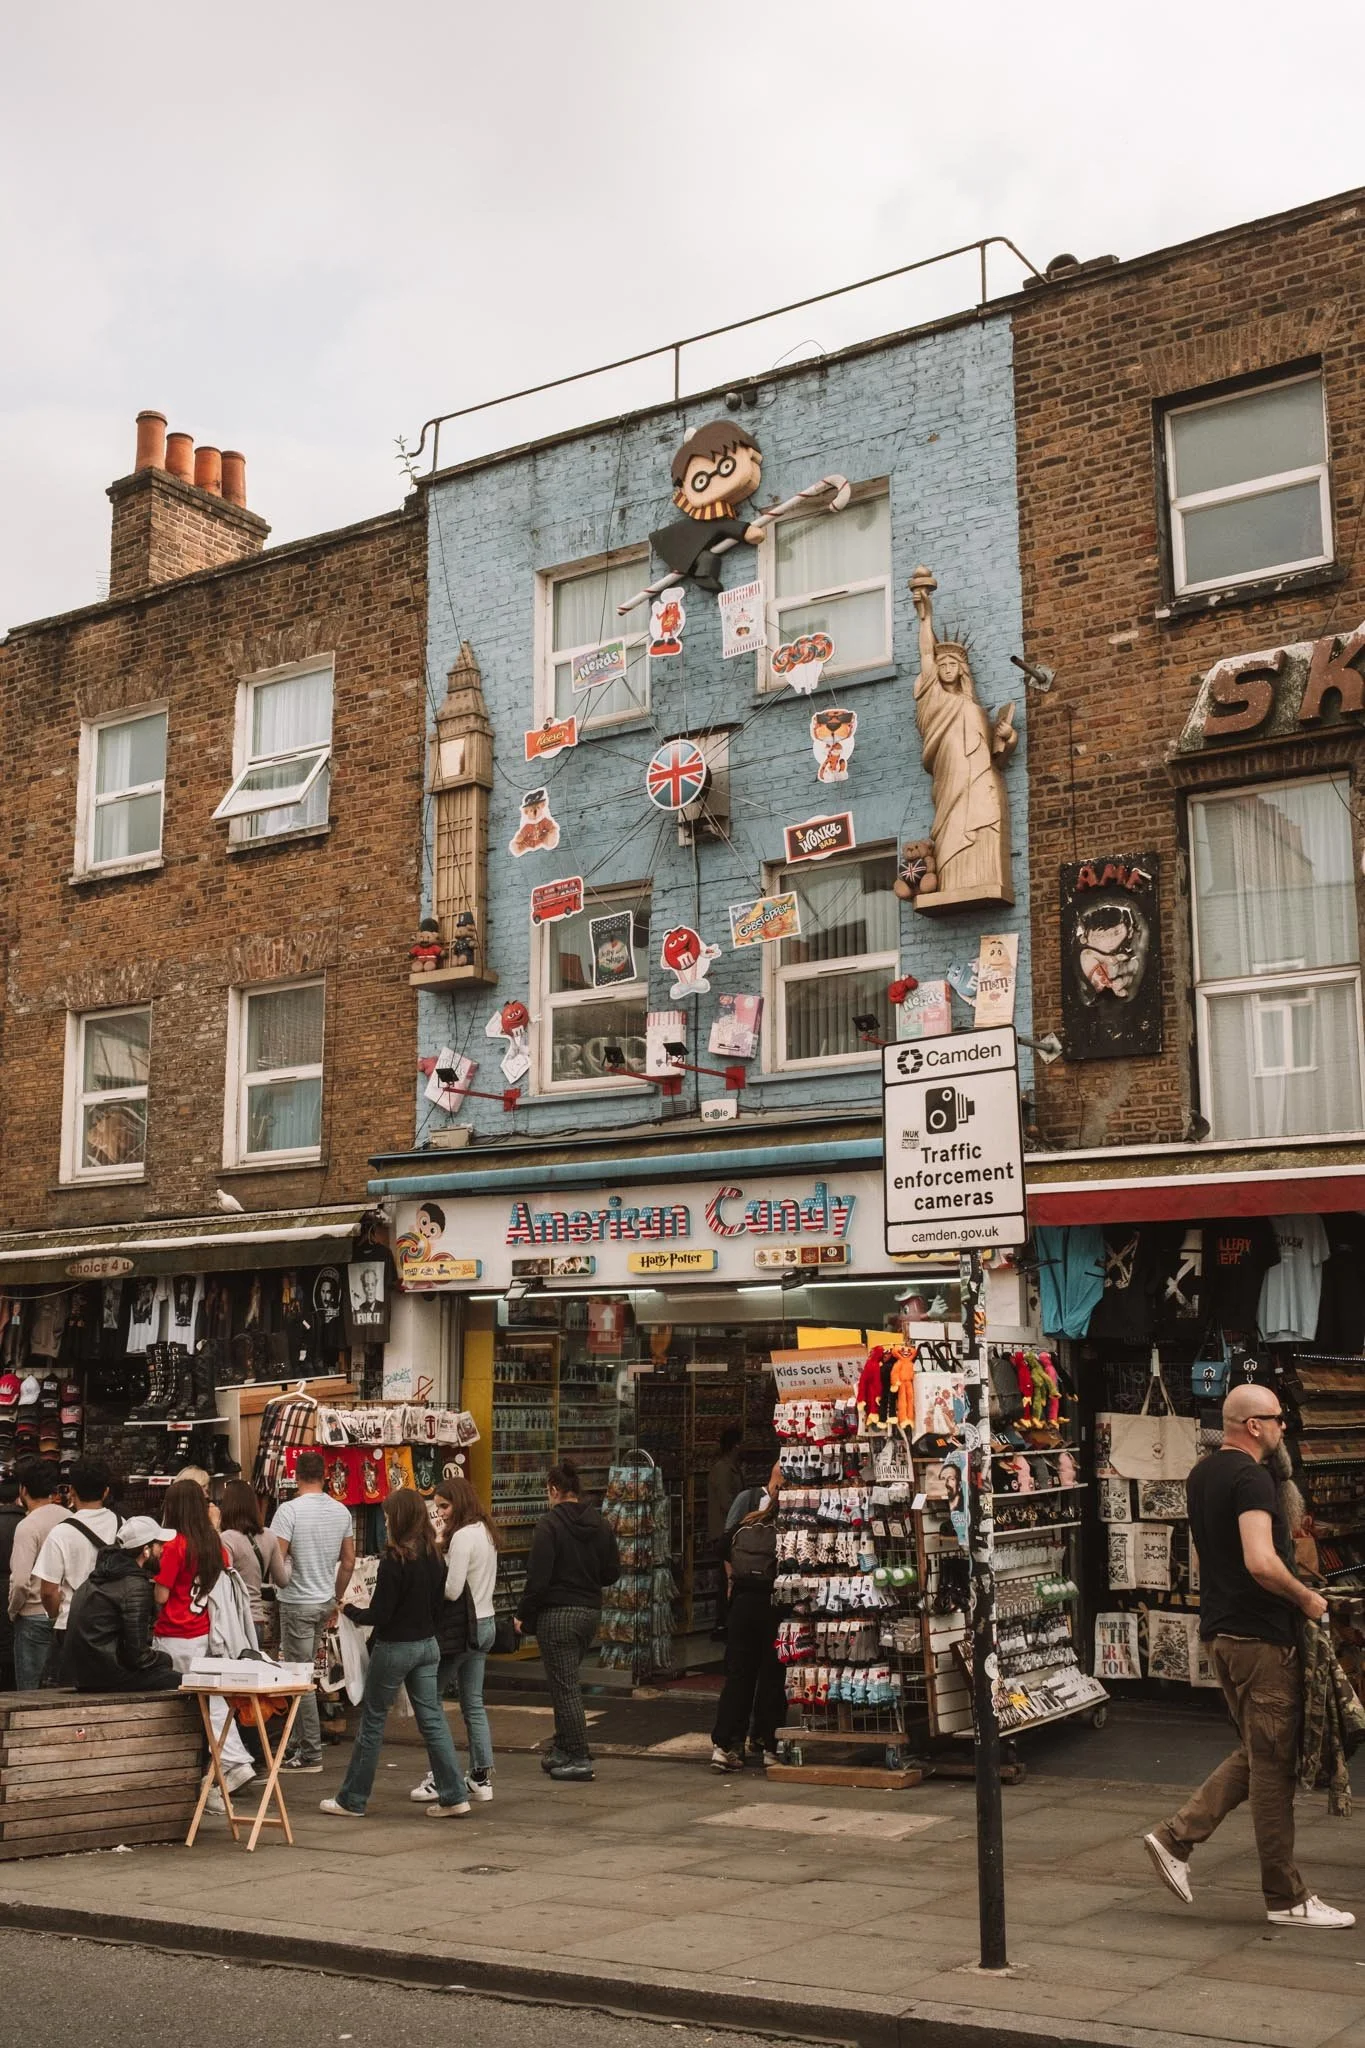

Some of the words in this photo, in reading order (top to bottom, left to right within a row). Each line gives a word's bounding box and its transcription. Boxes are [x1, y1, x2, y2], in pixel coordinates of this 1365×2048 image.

[799, 823, 842, 853] WONKA
[819, 838, 837, 849] BAR
[740, 903, 791, 937] GOBSTOPPER
[926, 1044, 1002, 1066] Camden
[921, 1143, 982, 1164] Traffic
[894, 1162, 1014, 1189] enforcement
[914, 1191, 994, 1210] cameras
[505, 1195, 692, 1246] American
[705, 1181, 857, 1239] Candy
[911, 1226, 999, 1243] camden.gov.uk
[70, 1262, 108, 1274] choice
[111, 1260, 118, 1271] 4
[122, 1261, 130, 1270] u
[639, 1255, 669, 1268] Harry
[670, 1252, 702, 1269] Potter
[776, 1366, 799, 1377] Kids
[801, 1364, 832, 1375] Socks
